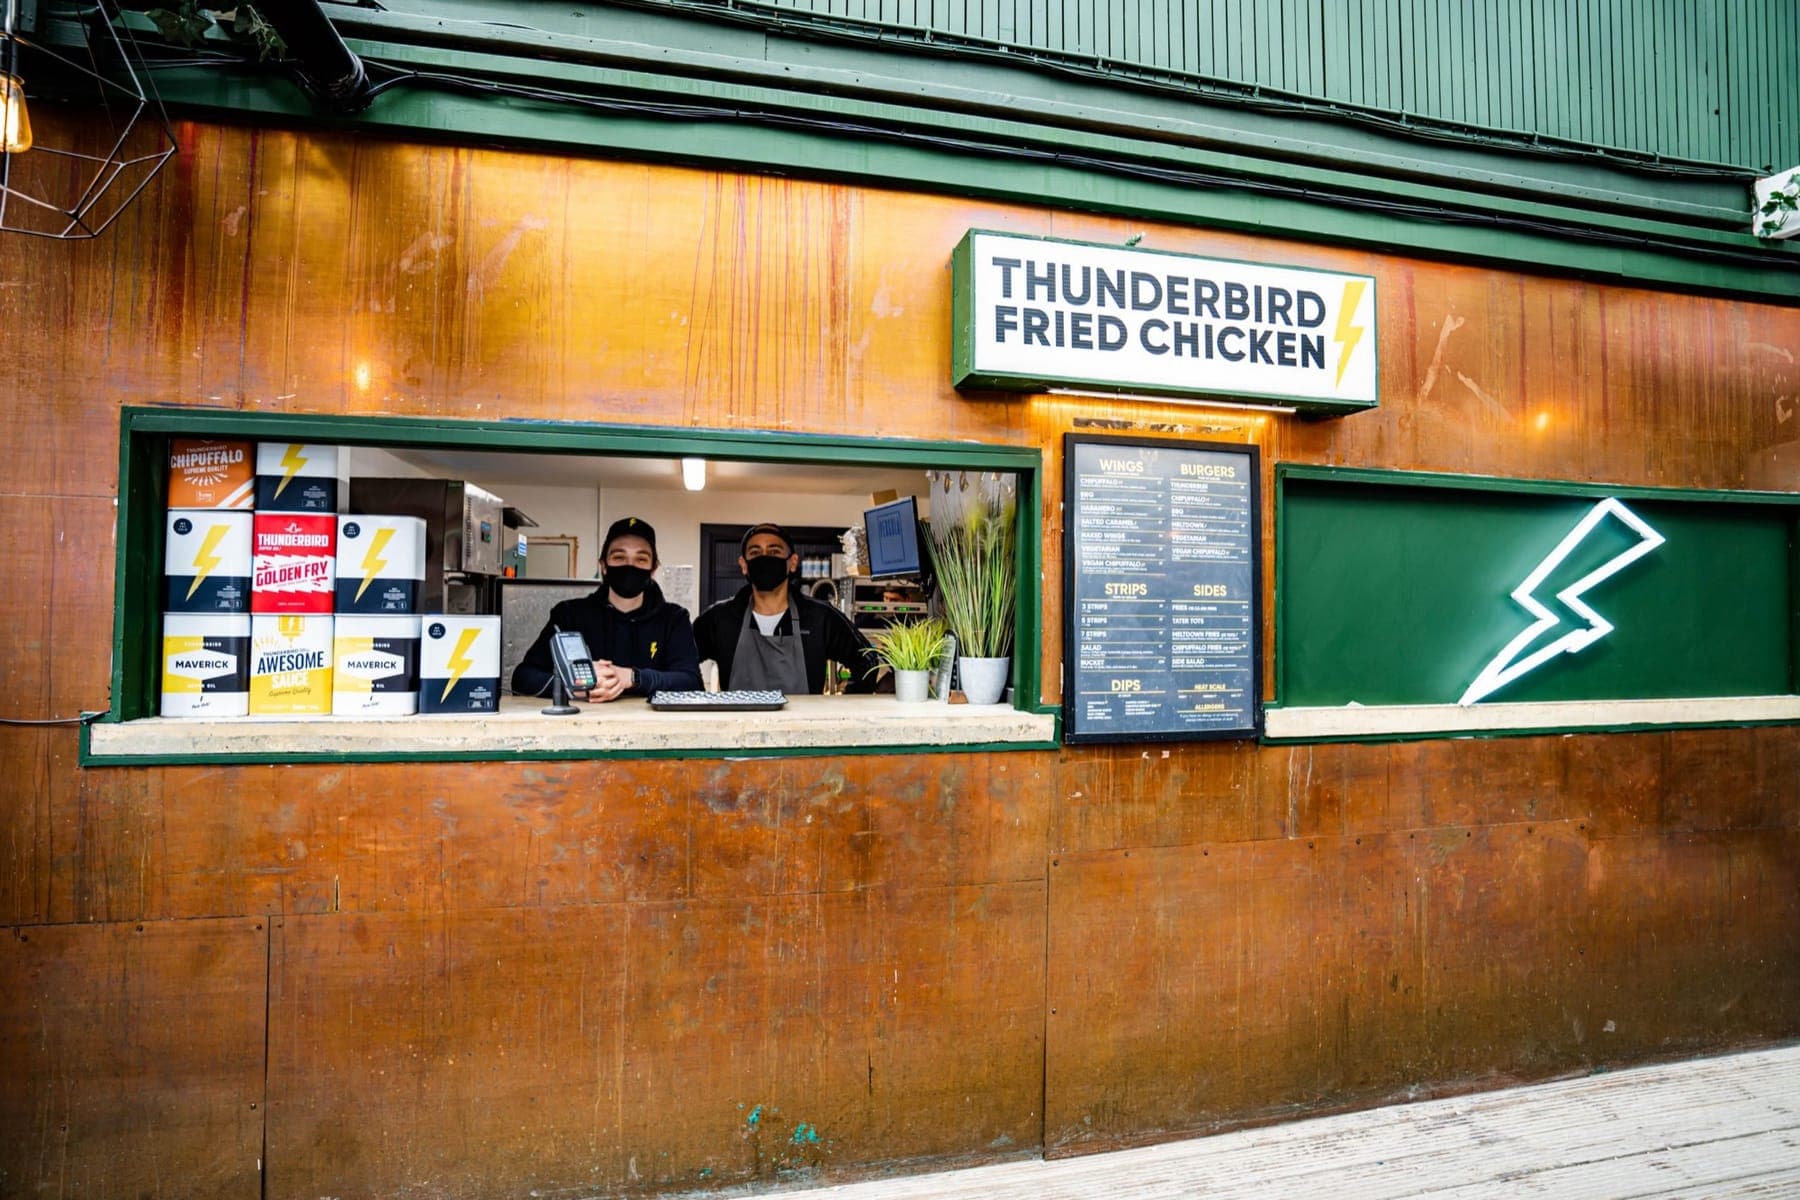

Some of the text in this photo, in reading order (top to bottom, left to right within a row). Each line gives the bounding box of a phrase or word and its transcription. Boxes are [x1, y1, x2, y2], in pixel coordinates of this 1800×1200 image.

[992, 256, 1326, 329] THUNDERBIRD
[995, 305, 1326, 370] FRIED CHICKEN
[170, 449, 243, 468] CHIPUFFALO
[1099, 459, 1144, 472] WINGS
[1180, 464, 1235, 478] BURGERS
[258, 533, 329, 547] THUNDERBIRD
[256, 566, 302, 586] GOLDEN
[304, 560, 328, 578] FRY
[1105, 583, 1148, 595] STRIPS
[1194, 584, 1227, 596] SIDES
[175, 660, 228, 669] MAVERICK
[257, 650, 324, 674] AWESOME
[347, 661, 396, 669] MAVERICK
[272, 672, 308, 689] SAUCE
[1111, 680, 1141, 691] DIPS
